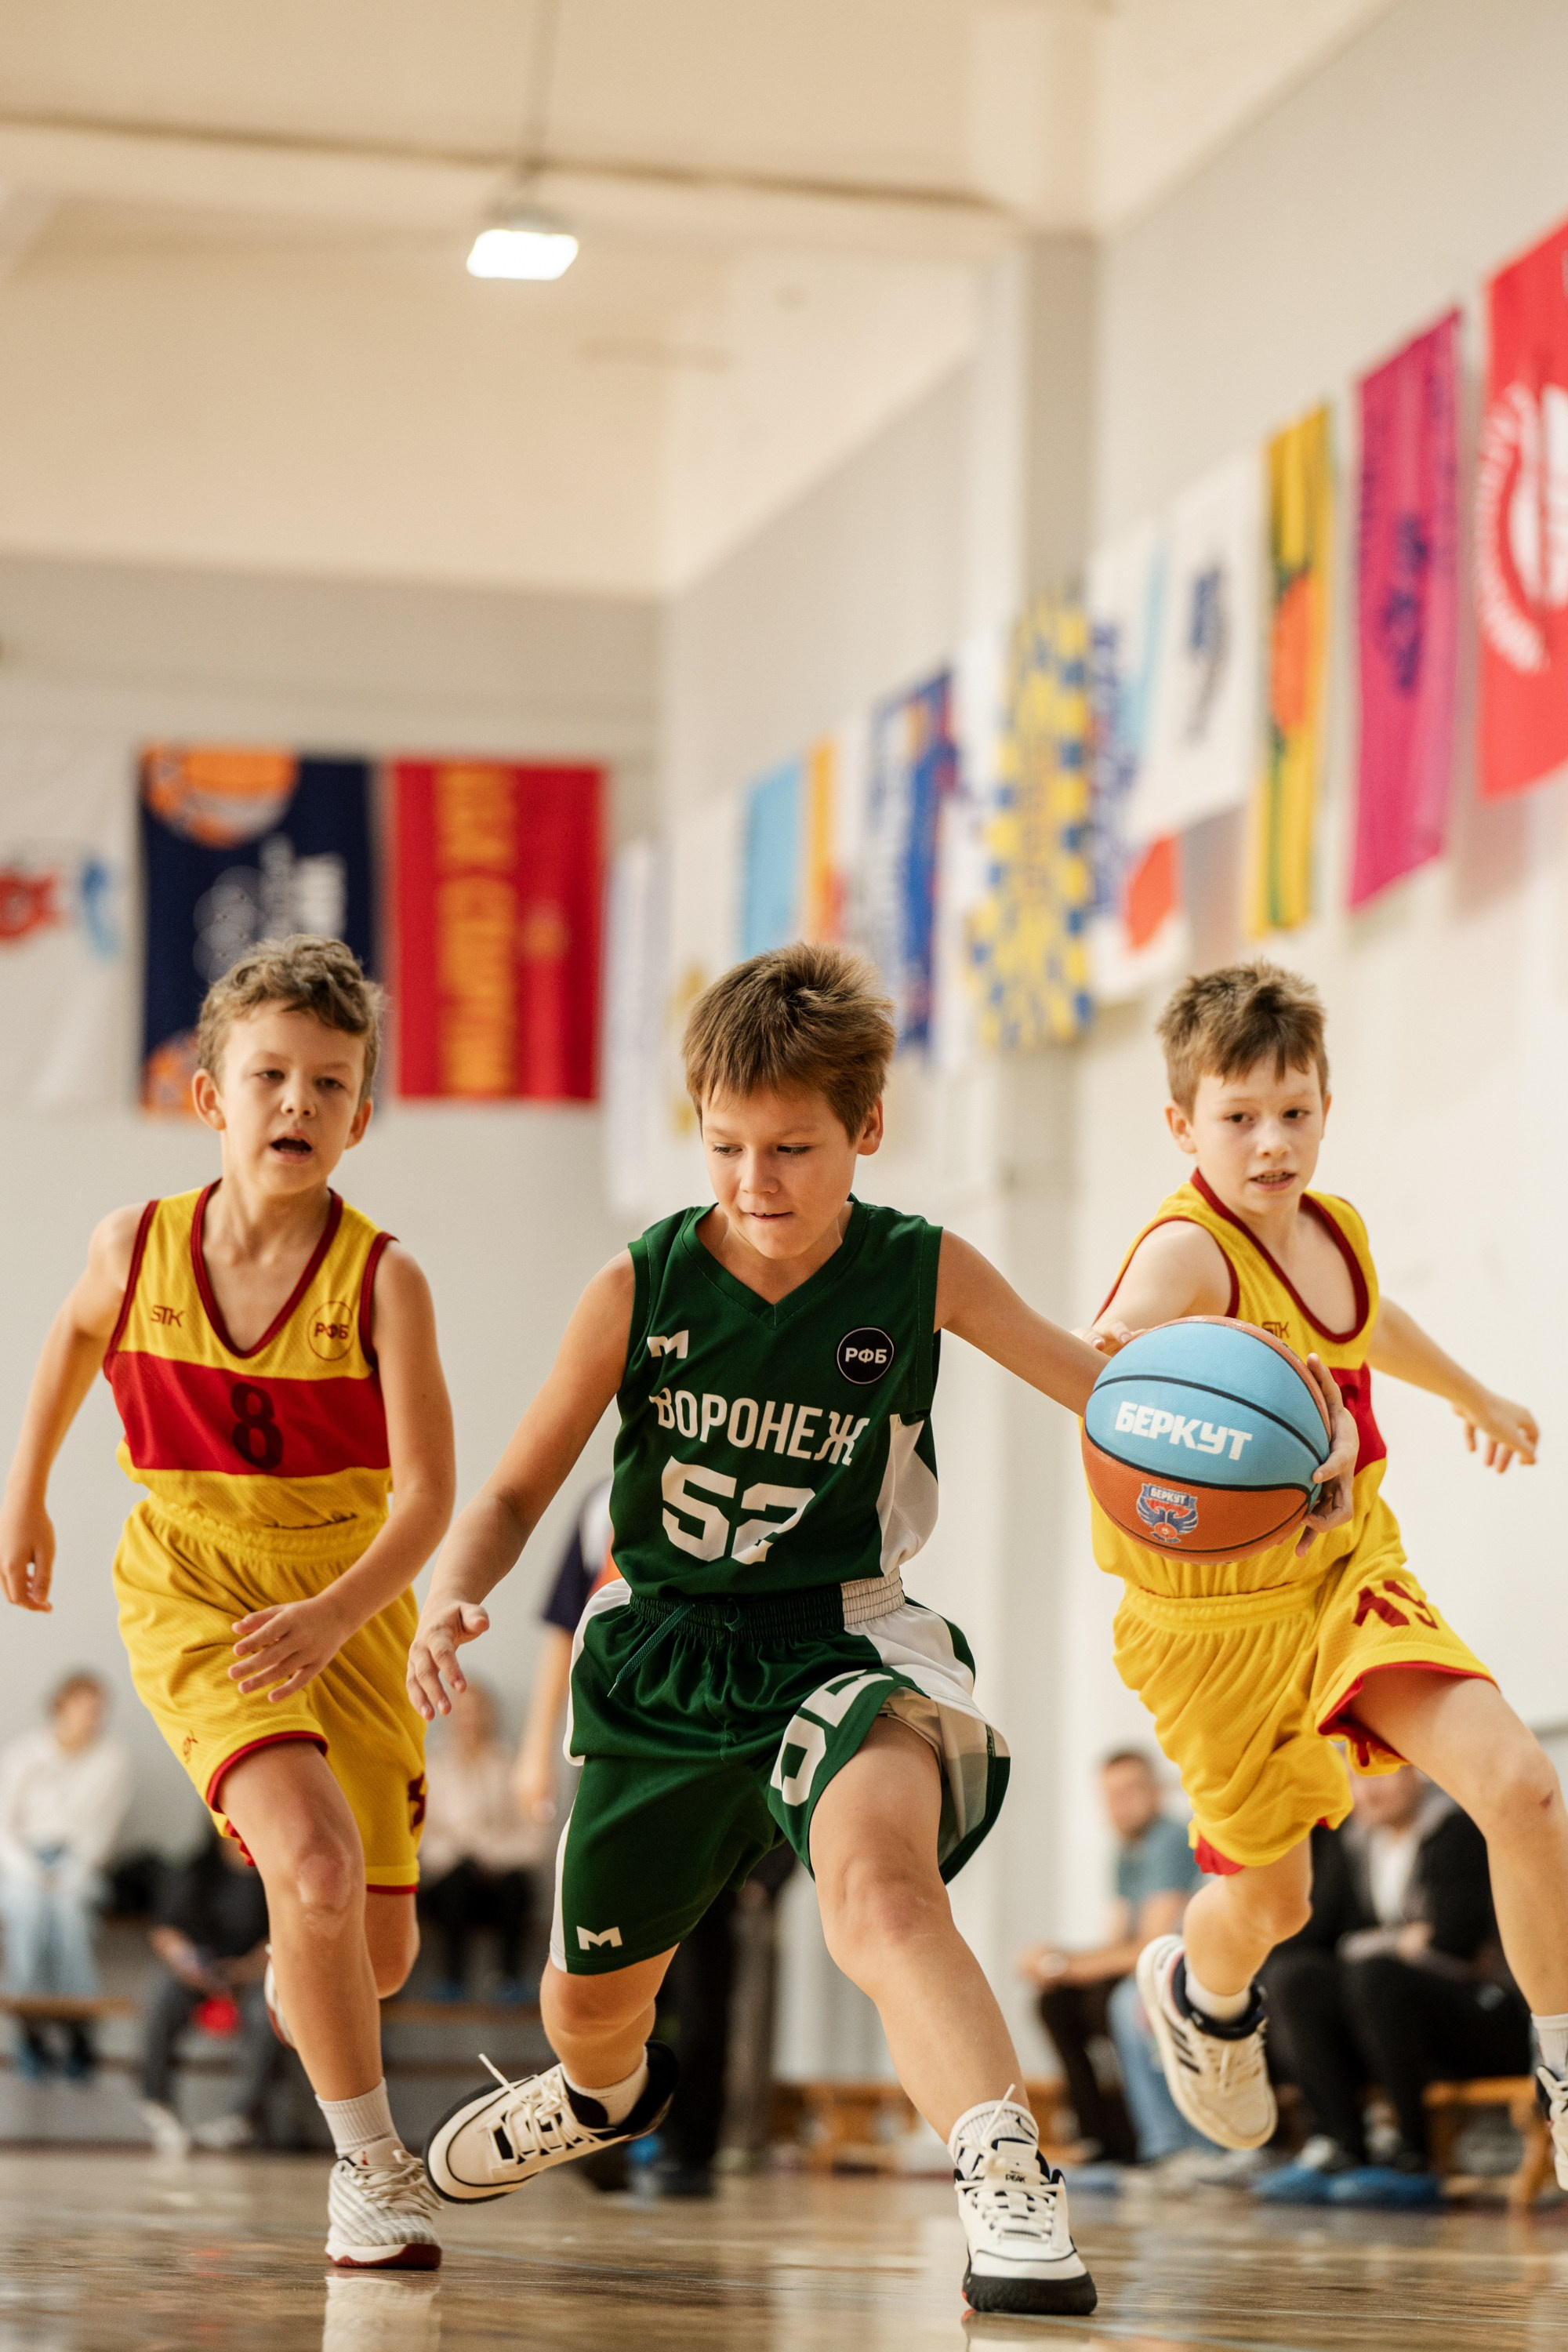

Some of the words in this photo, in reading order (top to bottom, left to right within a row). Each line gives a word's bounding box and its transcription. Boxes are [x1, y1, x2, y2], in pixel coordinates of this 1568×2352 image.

[151, 1305, 184, 1328] STK
[314, 1322, 350, 1339] РФБ
[844, 1346, 887, 1364] РФБ
[230, 1381, 285, 1470] 8
[648, 1387, 871, 1466] ВОРОНЕЖ
[1114, 1400, 1254, 1461] БЕРКУТ
[661, 1455, 816, 1565] 52
[1150, 1486, 1186, 1505] БЕРКУТ
